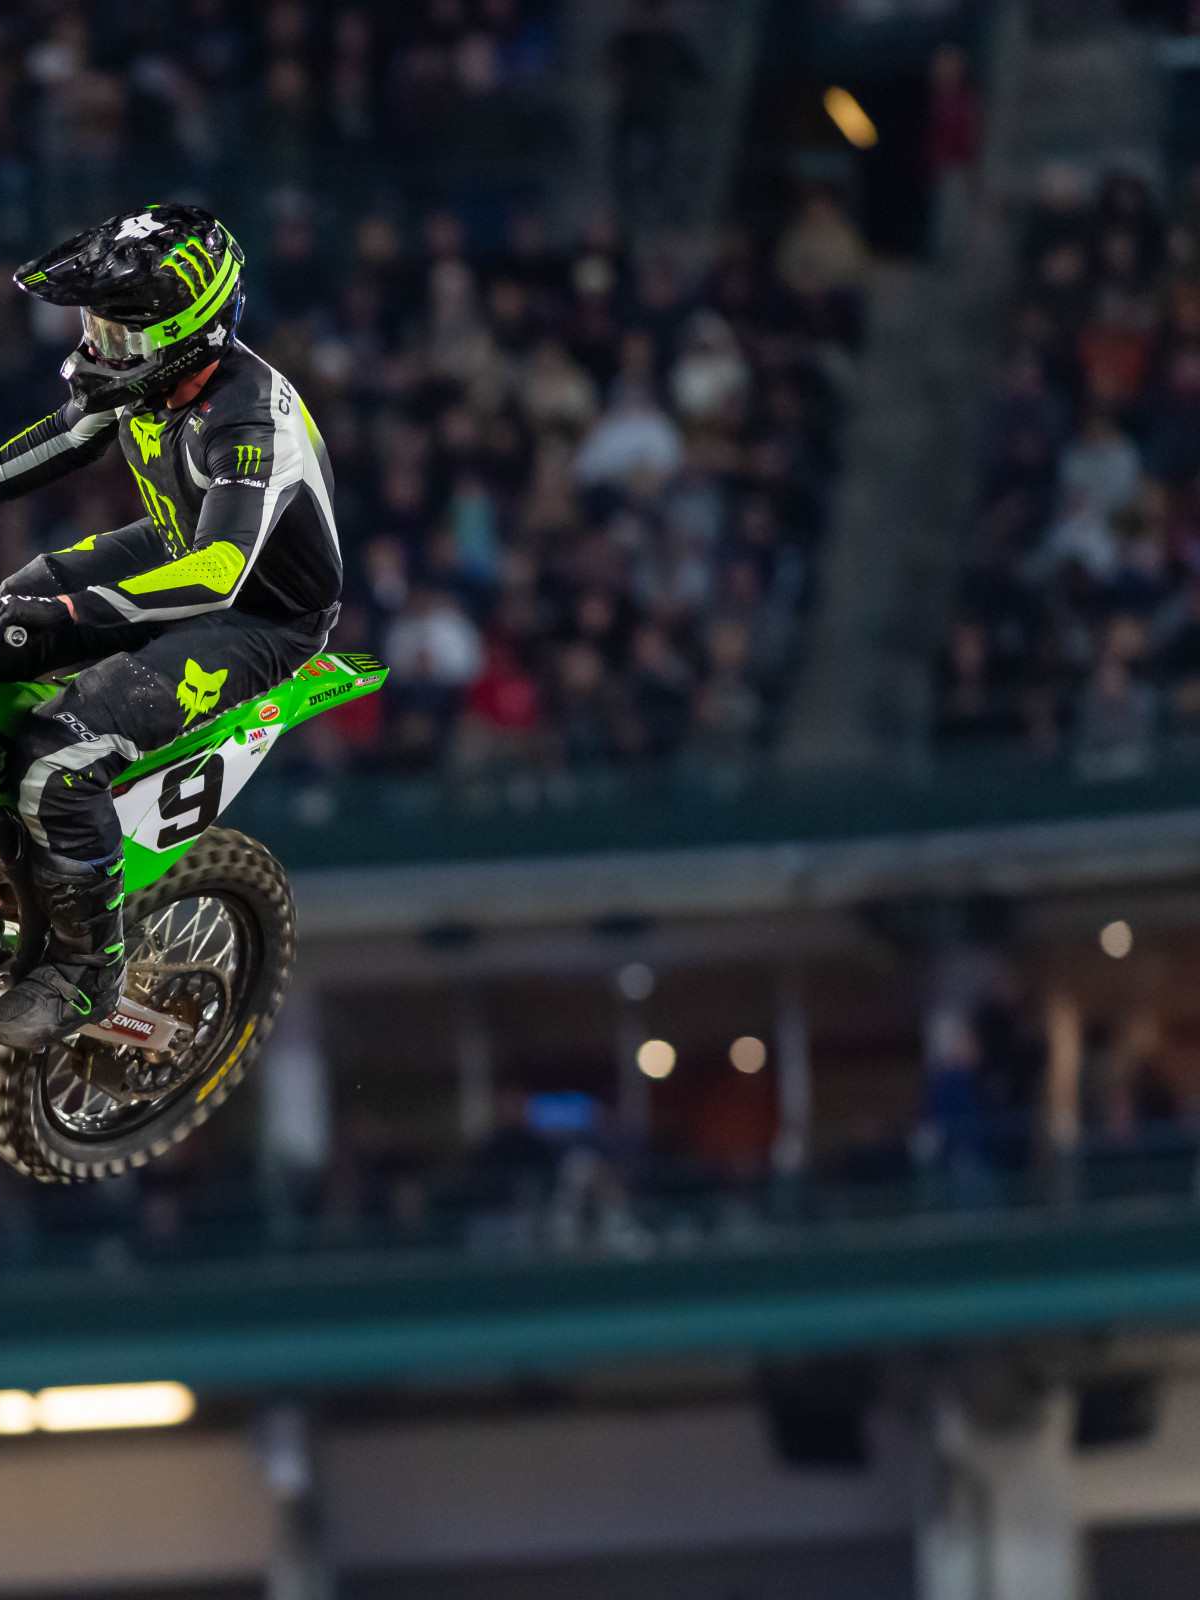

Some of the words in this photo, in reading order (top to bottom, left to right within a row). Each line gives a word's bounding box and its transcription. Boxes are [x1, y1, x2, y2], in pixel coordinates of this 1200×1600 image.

[309, 682, 353, 706] DUNLOP
[248, 728, 268, 744] AMA
[157, 753, 225, 850] 9
[112, 1011, 154, 1035] ENTHAL
